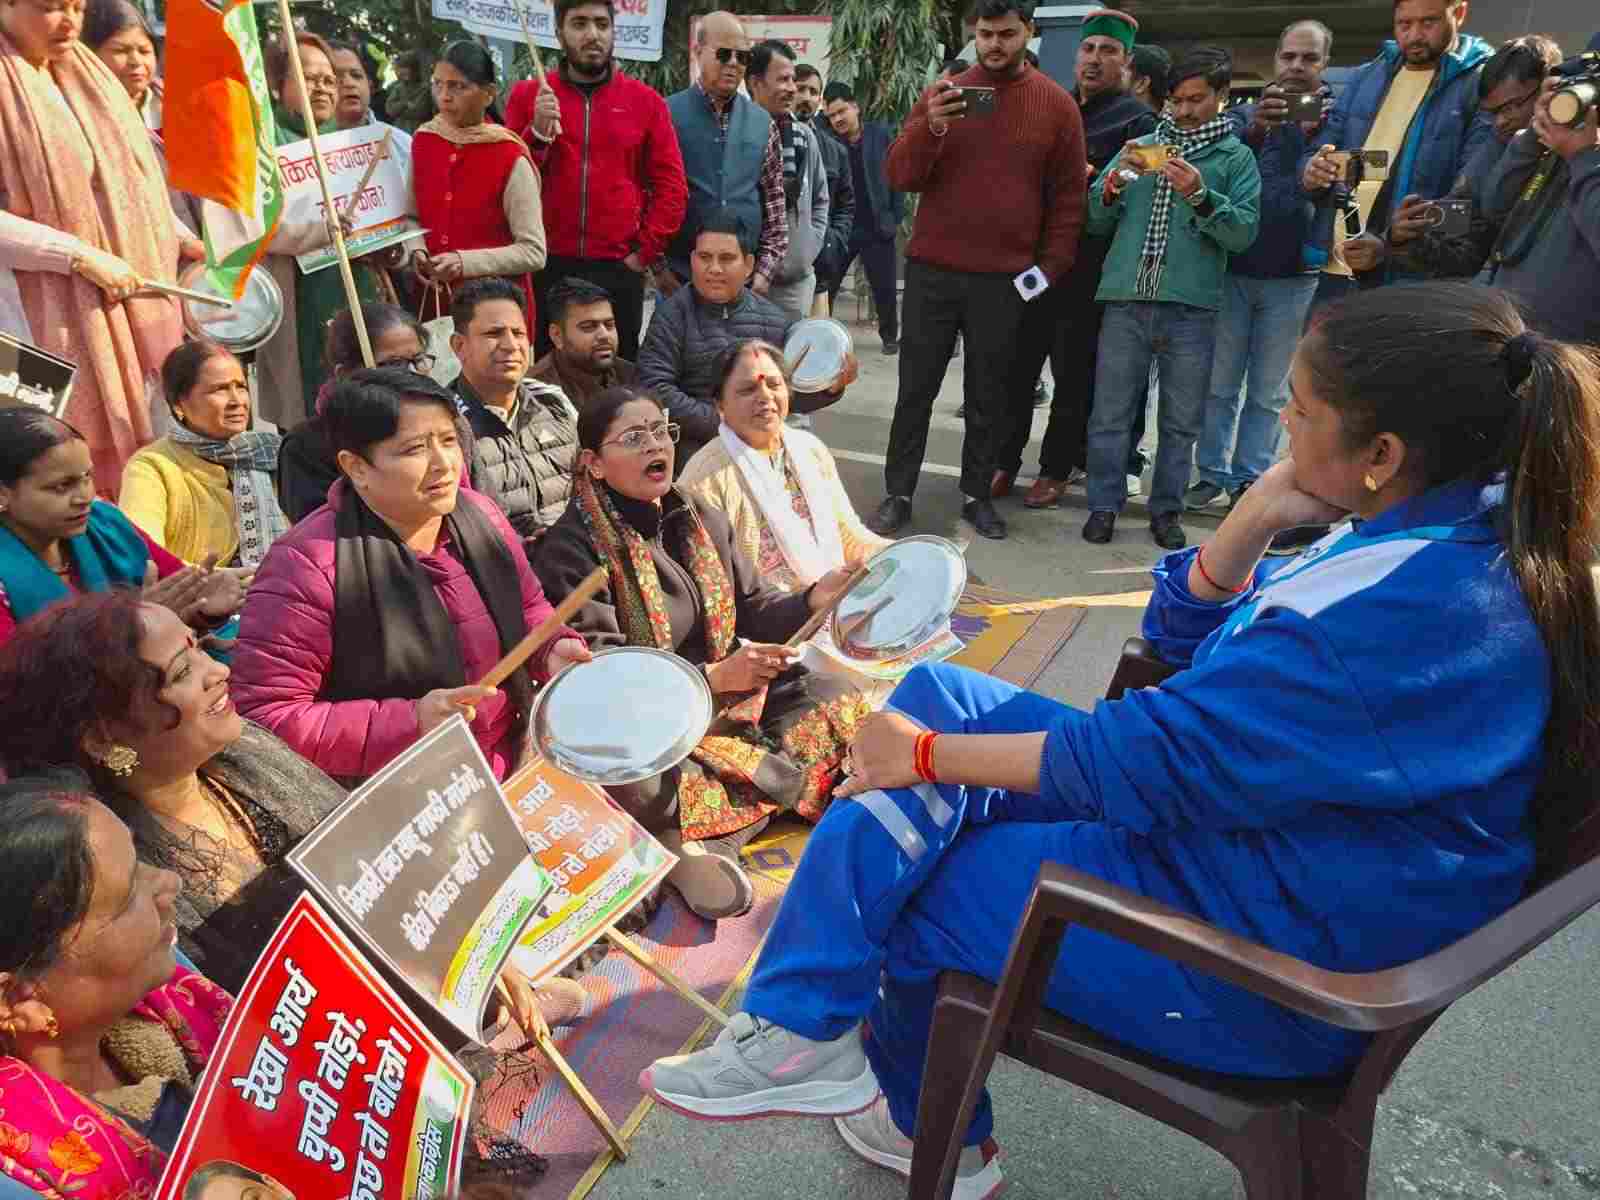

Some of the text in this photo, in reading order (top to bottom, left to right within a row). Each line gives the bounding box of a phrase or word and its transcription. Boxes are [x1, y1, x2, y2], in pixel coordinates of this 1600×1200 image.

[231, 957, 319, 1111] रेखा आर्य
[297, 1079, 345, 1172] चुप्पी
[353, 1111, 389, 1160] तो
